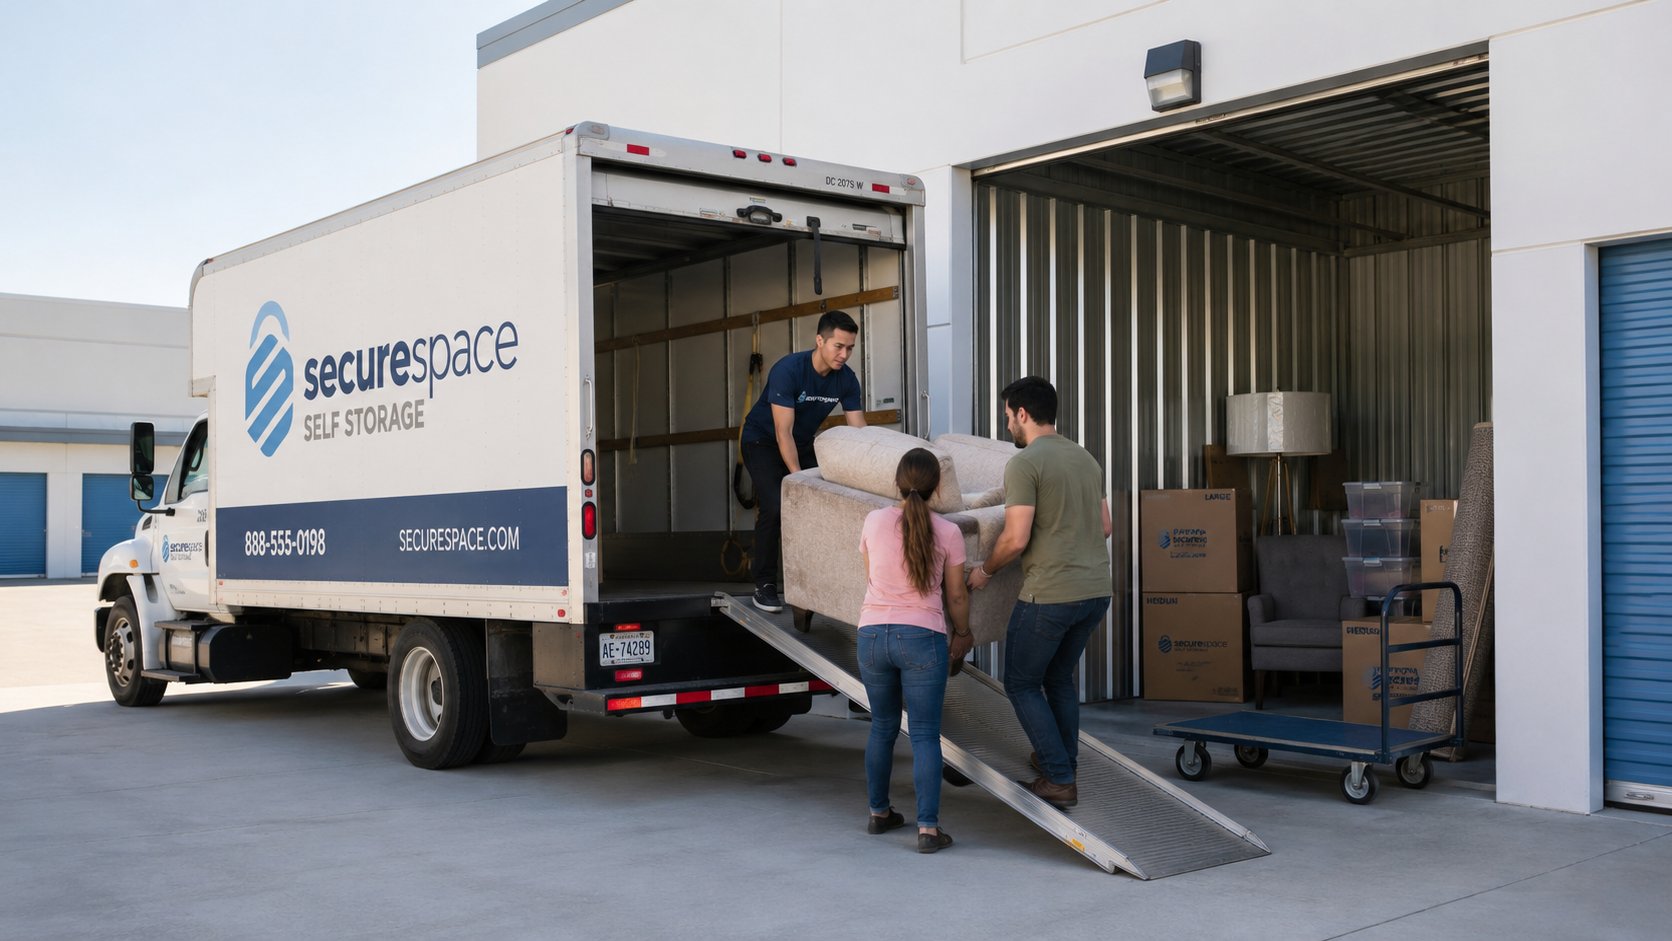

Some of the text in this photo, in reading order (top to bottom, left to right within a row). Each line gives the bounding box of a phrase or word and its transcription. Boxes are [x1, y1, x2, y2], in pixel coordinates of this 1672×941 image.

[826, 176, 836, 186] DC
[856, 181, 864, 190] W
[303, 321, 518, 399] securespace
[304, 399, 425, 441] SELF STORAGE
[245, 528, 326, 556] 888-555-0198
[399, 526, 520, 552] SECURESPACE.COM
[602, 640, 650, 659] AE-74289
